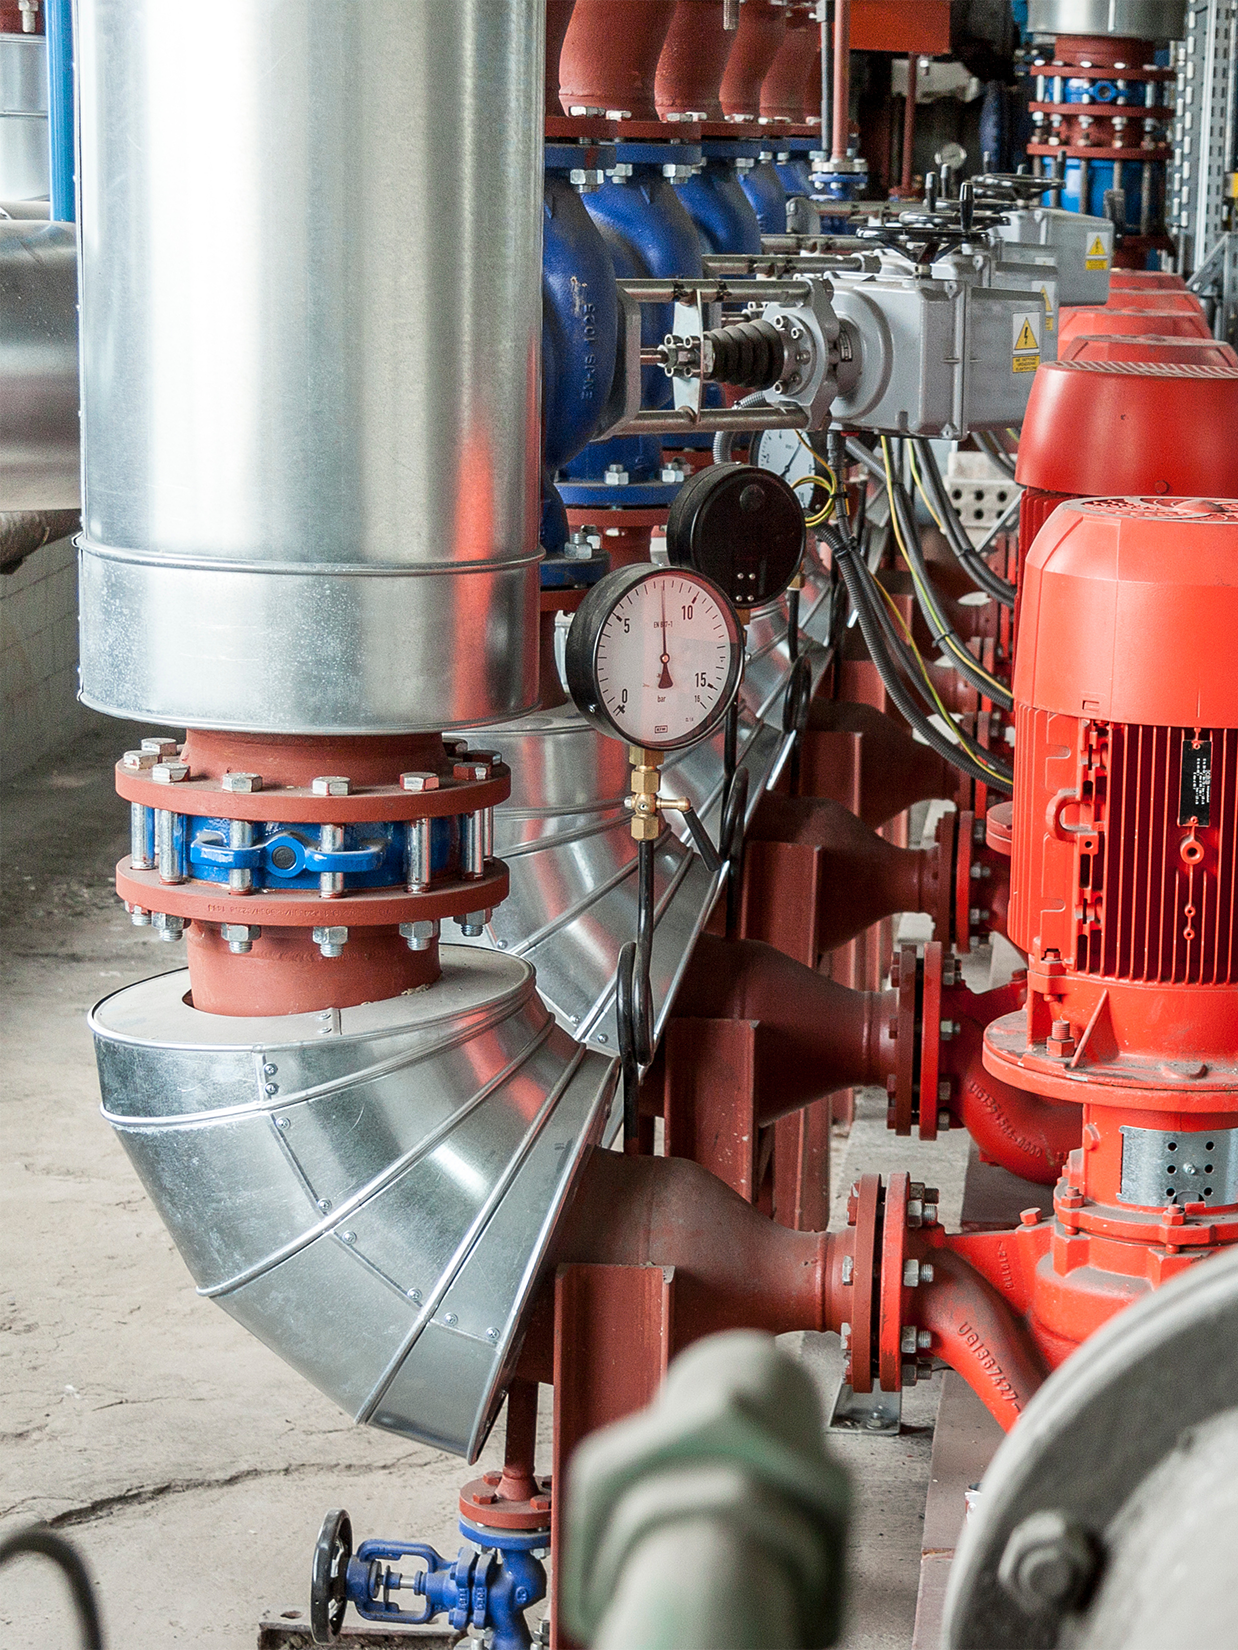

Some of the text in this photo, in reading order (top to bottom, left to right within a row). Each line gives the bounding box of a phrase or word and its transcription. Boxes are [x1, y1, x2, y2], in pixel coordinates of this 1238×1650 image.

[681, 604, 693, 620] 10
[623, 618, 630, 633] 5
[694, 672, 706, 688] 15
[621, 688, 628, 704] 0
[657, 695, 667, 703] bar
